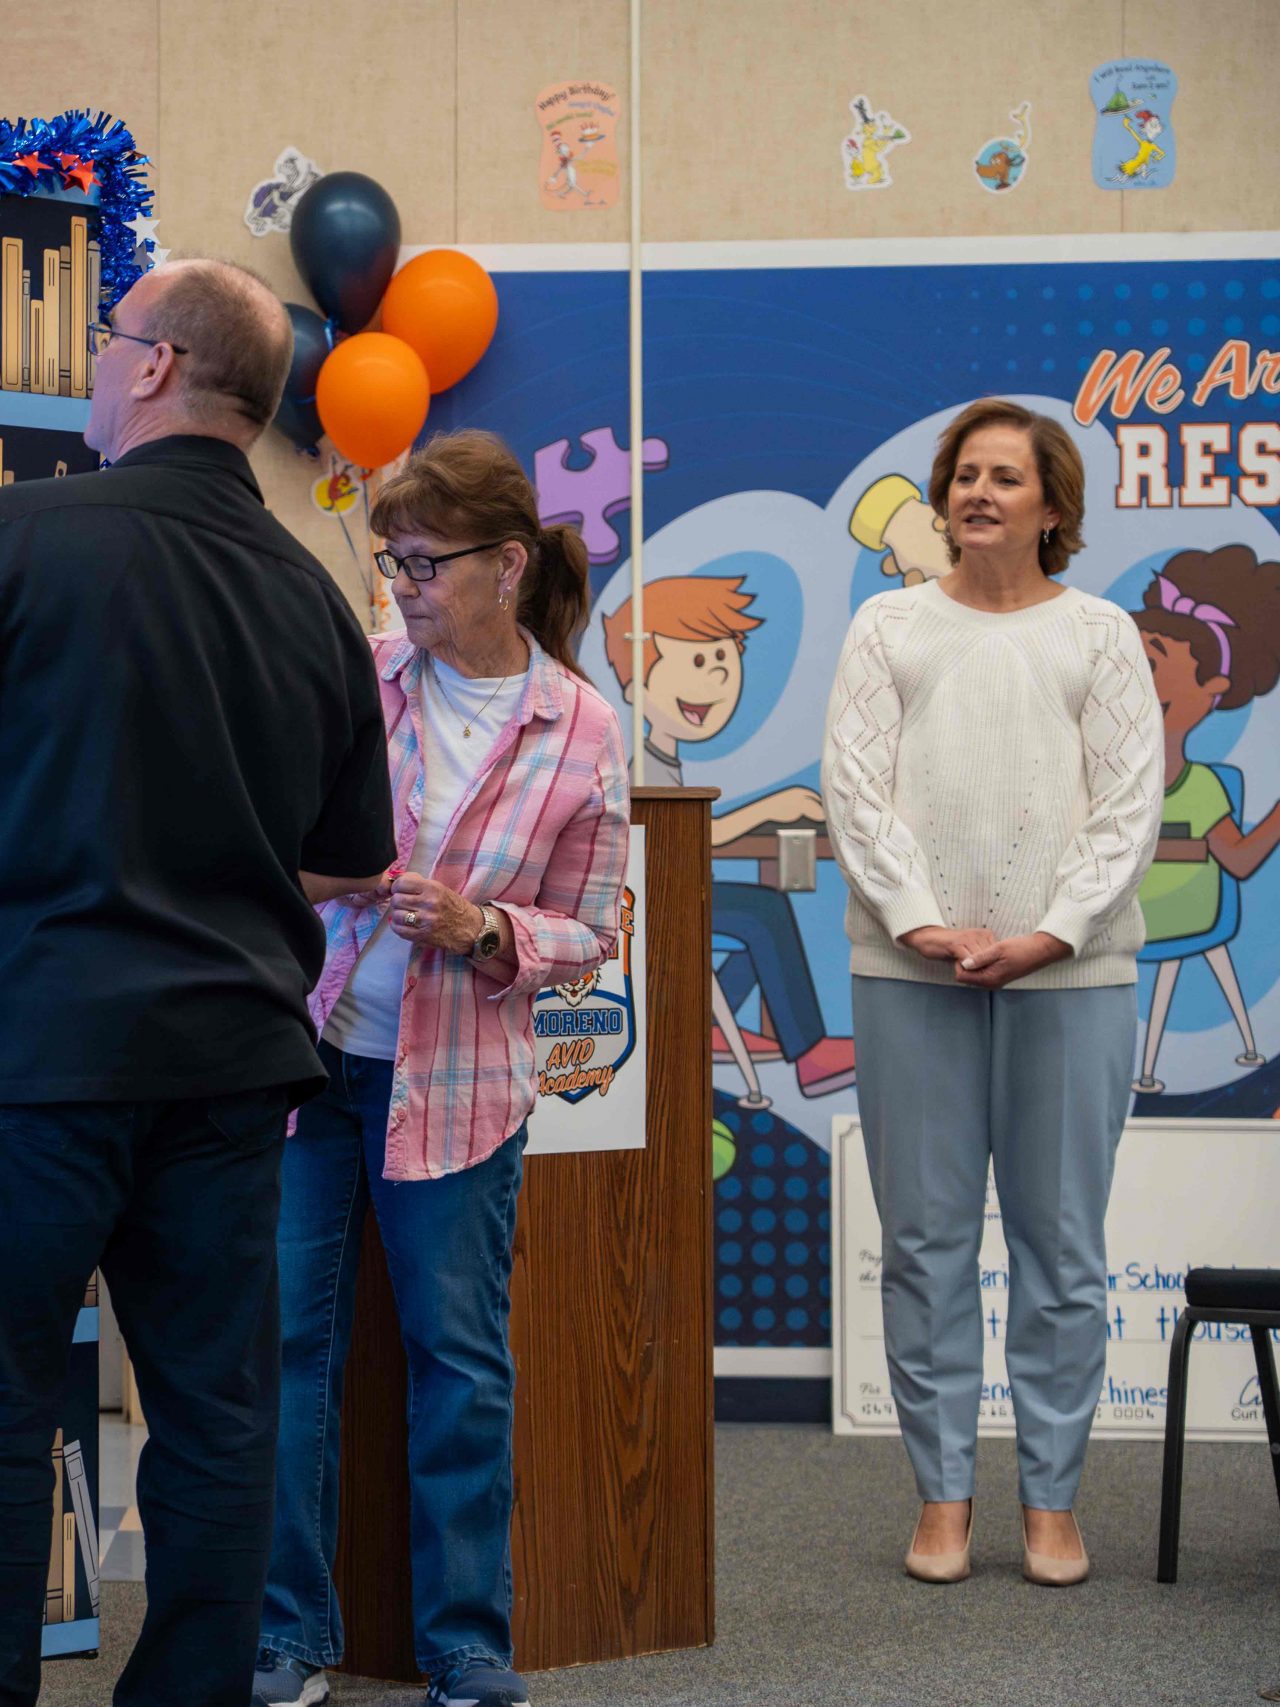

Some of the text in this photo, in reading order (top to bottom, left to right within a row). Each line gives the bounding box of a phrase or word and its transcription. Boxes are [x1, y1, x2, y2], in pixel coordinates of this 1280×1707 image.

[538, 91, 568, 111] Happy
[1073, 339, 1280, 427] We Ar
[1116, 422, 1280, 508] RES
[531, 1007, 624, 1037] MORENO
[546, 1037, 596, 1070] AVID
[537, 1064, 615, 1097] Academy
[1125, 1261, 1191, 1290] Schoo
[1103, 1375, 1169, 1407] hines
